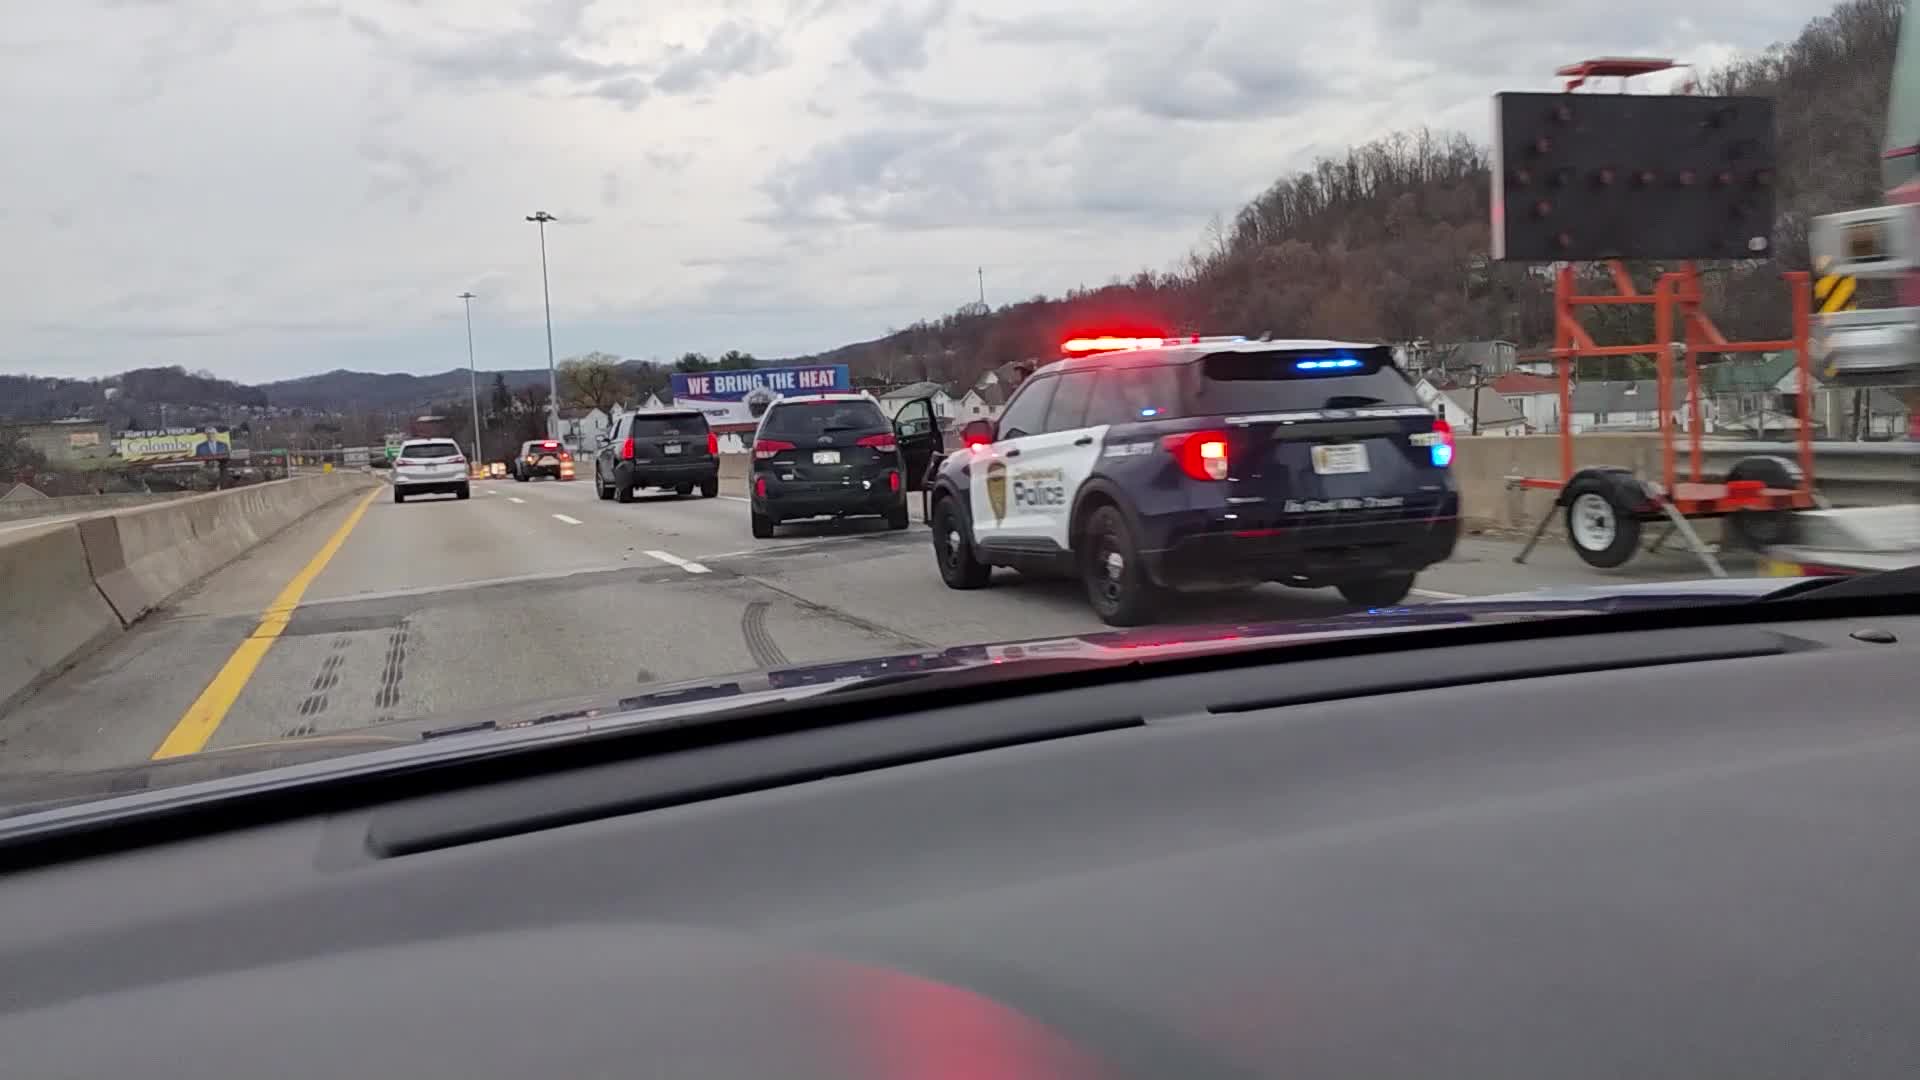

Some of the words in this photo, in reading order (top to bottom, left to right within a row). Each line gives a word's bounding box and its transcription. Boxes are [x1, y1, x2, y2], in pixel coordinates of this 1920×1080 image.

[687, 377, 710, 395] WE
[714, 373, 763, 393] BRING
[767, 372, 795, 390] THE
[799, 369, 835, 388] HEAT
[127, 439, 192, 453] Colombo
[1013, 481, 1066, 506] Police
